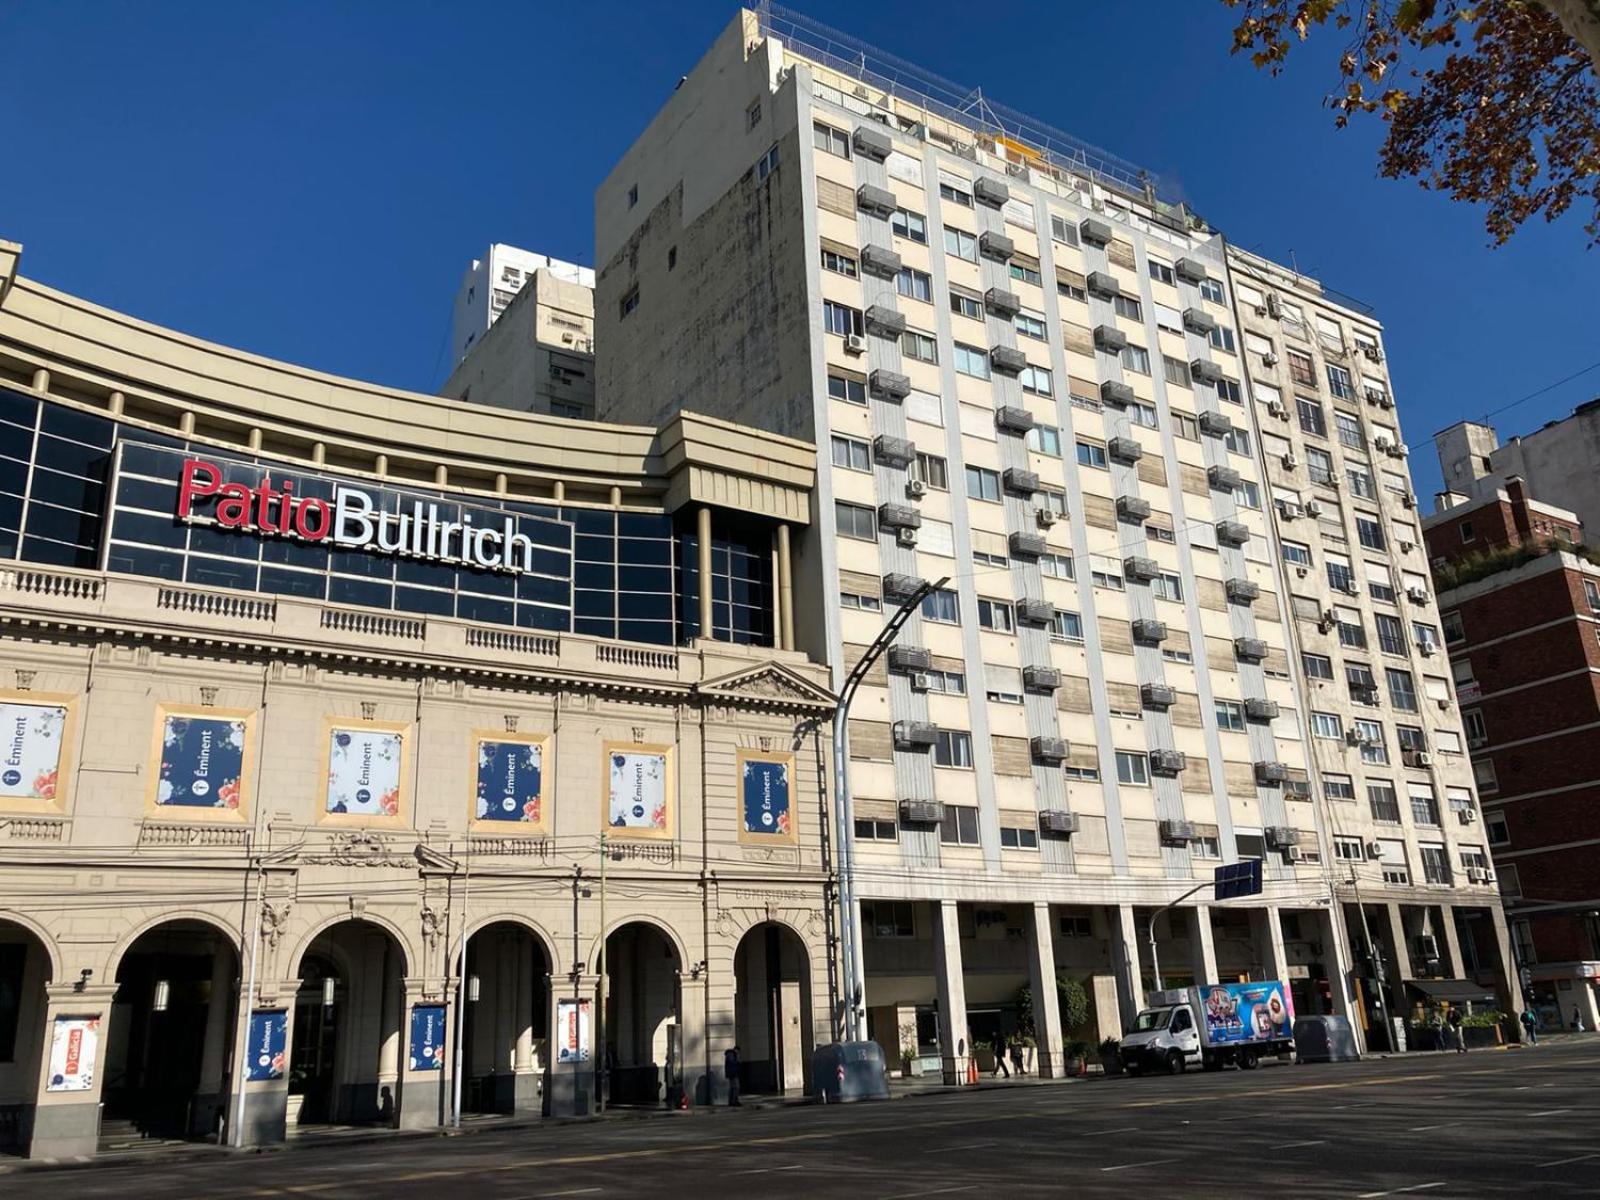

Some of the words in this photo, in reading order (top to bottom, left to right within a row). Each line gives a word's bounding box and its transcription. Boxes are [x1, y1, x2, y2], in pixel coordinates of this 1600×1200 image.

[8, 717, 27, 767] Éminent
[193, 729, 213, 777] Éminent
[357, 742, 372, 786] Éminent
[503, 753, 516, 795] Éminent
[632, 762, 643, 802] Éminent
[761, 771, 770, 811] Éminent
[260, 1020, 273, 1053] Éminent
